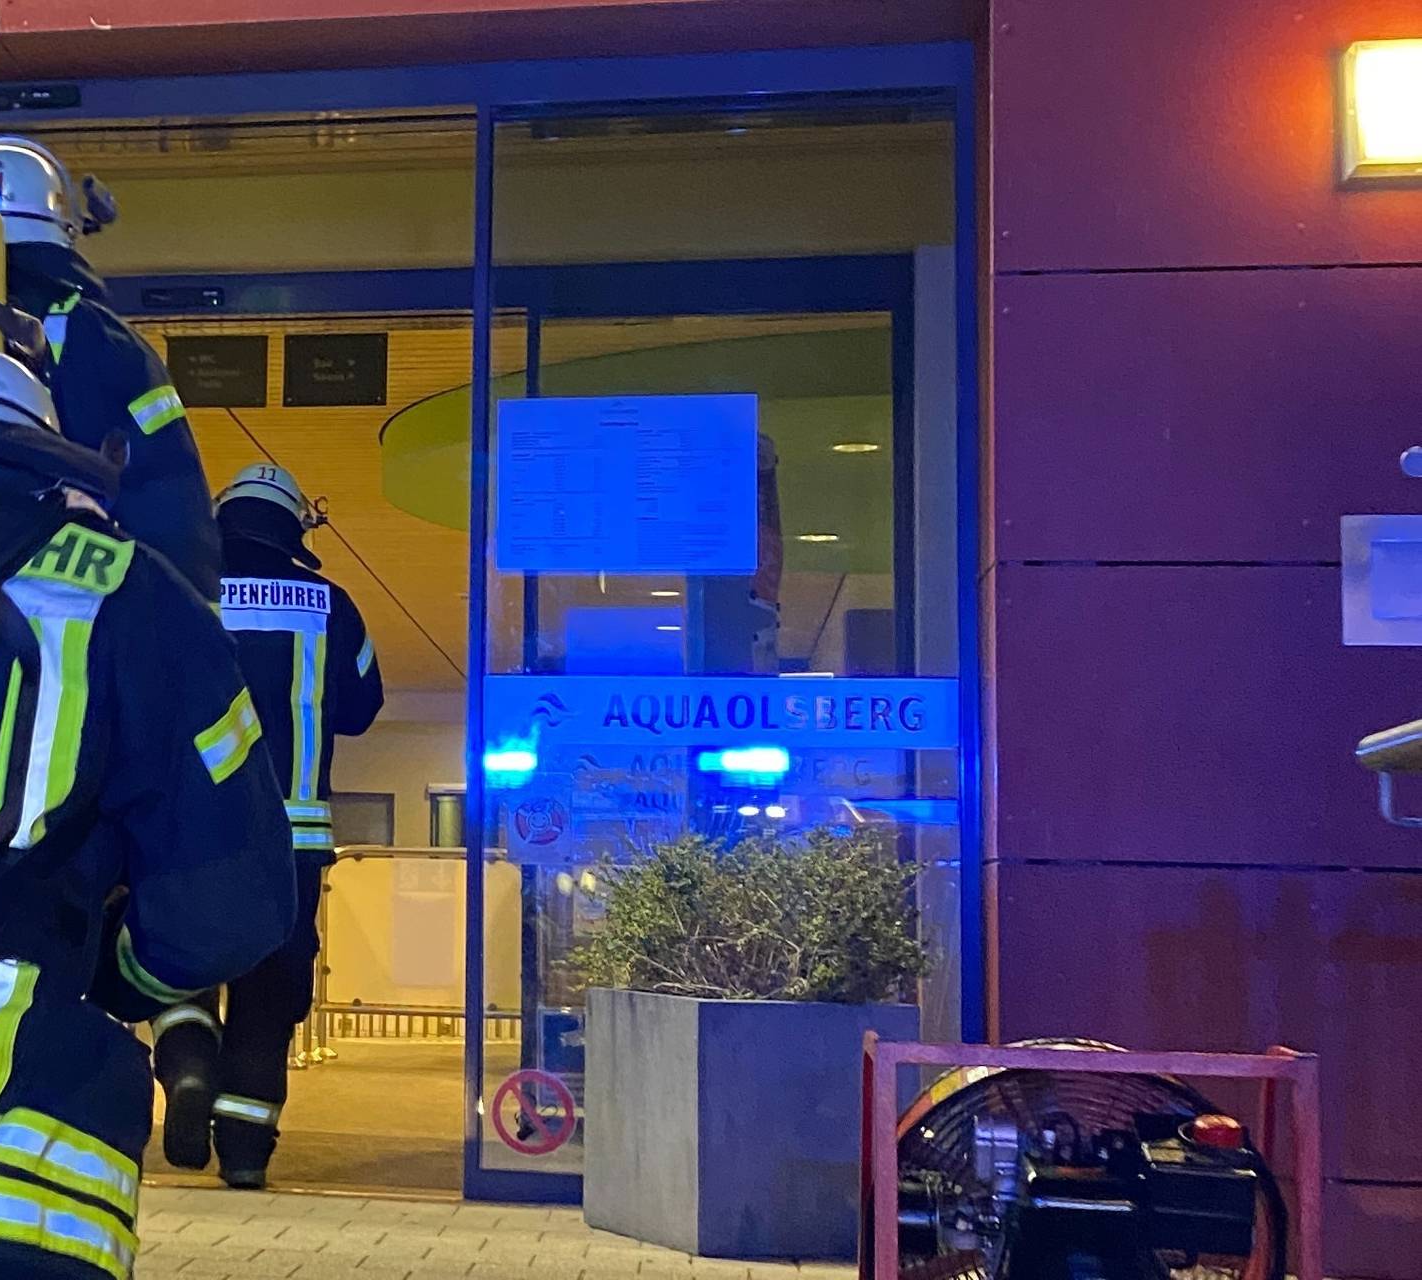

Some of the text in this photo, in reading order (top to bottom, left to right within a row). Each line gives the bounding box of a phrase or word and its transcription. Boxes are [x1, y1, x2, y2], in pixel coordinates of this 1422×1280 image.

[257, 466, 277, 482] 11
[29, 531, 116, 586] HR
[602, 693, 925, 735] AQUAOLSBERG
